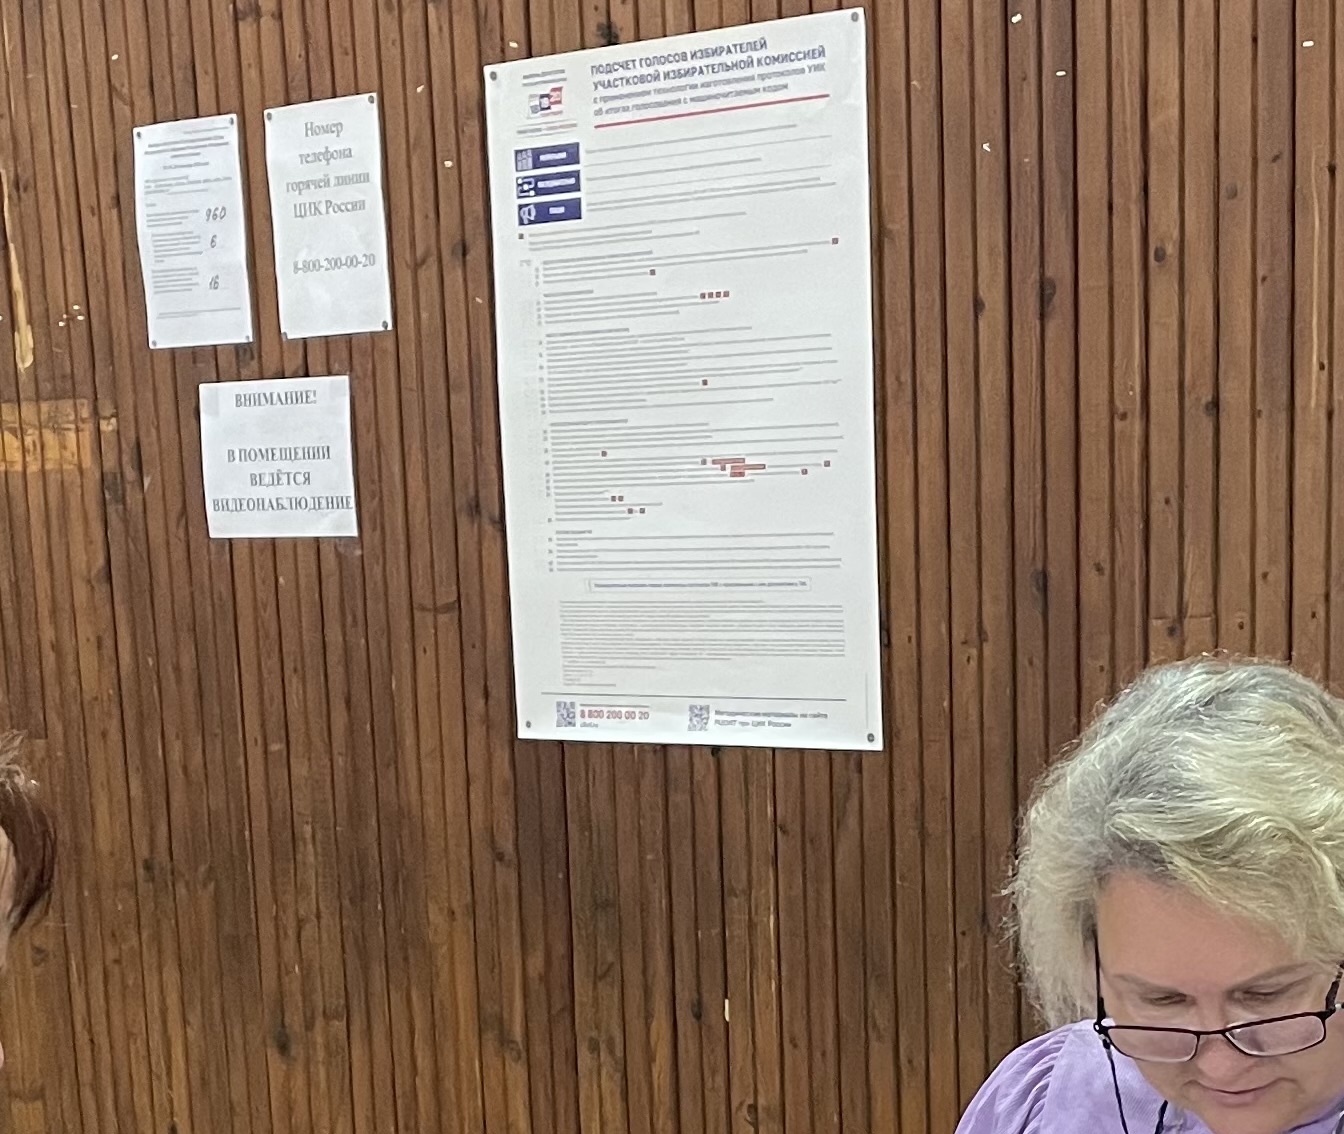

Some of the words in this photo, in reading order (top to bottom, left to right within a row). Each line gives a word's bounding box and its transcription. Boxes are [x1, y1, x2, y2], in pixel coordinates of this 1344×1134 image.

[591, 59, 637, 76] ПОДСЧЕТ
[639, 51, 688, 68] ГОЛОСОВ
[690, 37, 768, 61] ИЗБИРАТЕЛЕЙ
[593, 69, 661, 91] УЧАСТКОВОЙ
[663, 55, 755, 81] ИЗБИРАТЕЛЬНОЙ
[756, 45, 826, 67] КОМИССИЕЙ
[304, 120, 344, 139] Номер
[298, 146, 353, 166] телефона
[286, 173, 330, 195] горячей
[332, 171, 371, 188] линии
[293, 200, 323, 220] ЦИК
[324, 198, 366, 215] России
[293, 253, 376, 274] 8-800-200-00-20
[235, 389, 317, 408] ВНИМАНИЕ!
[227, 448, 237, 463] В
[239, 445, 332, 463] ПОМЕЩЕНИИ
[213, 494, 354, 513] ВИДЕОНАБЛЮДЕНИЕ
